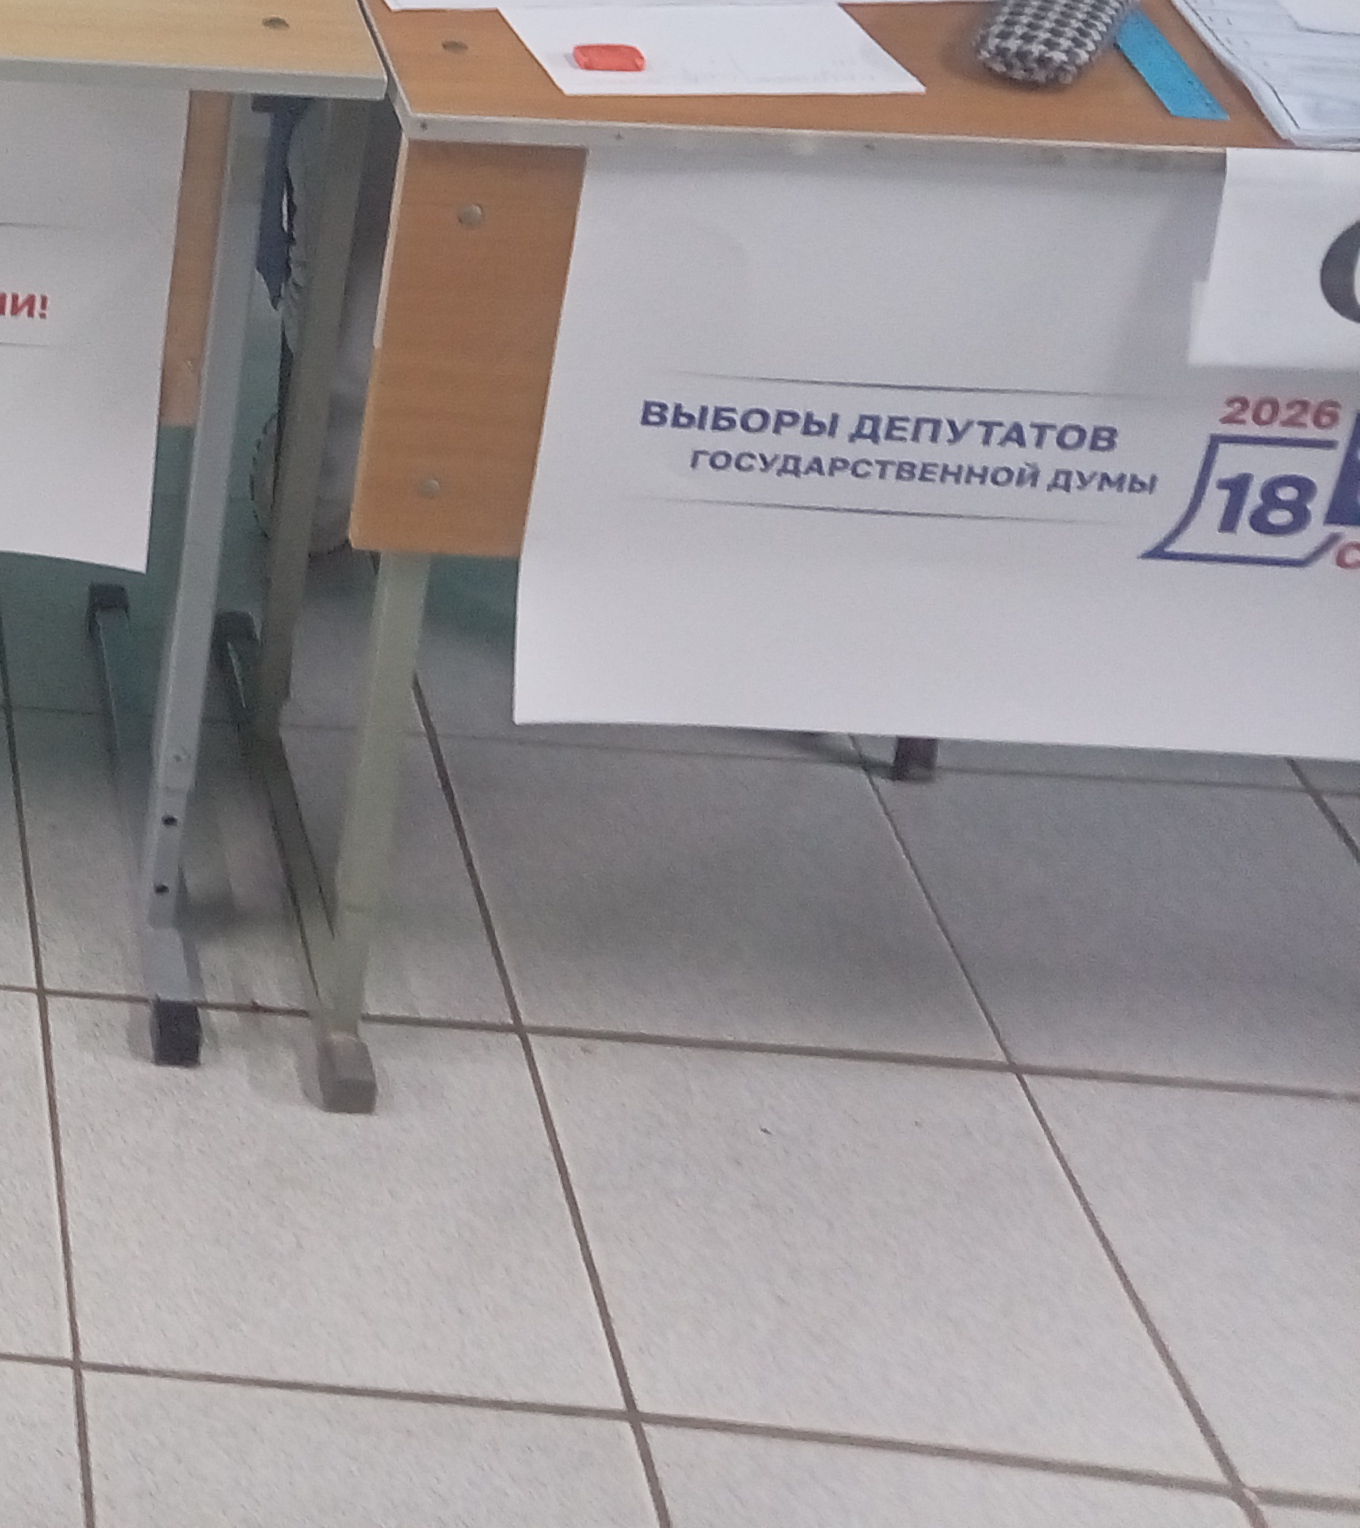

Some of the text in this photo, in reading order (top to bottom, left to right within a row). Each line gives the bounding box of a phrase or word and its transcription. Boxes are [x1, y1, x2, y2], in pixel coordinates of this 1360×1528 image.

[640, 400, 1119, 453] ВЫБОРЫ ДЕПУТАТОВ
[1218, 395, 1342, 429] 2026
[689, 448, 1159, 495] ГОСУДАРСТВЕННОЙ ДУМЫ
[1215, 472, 1318, 537] 18
